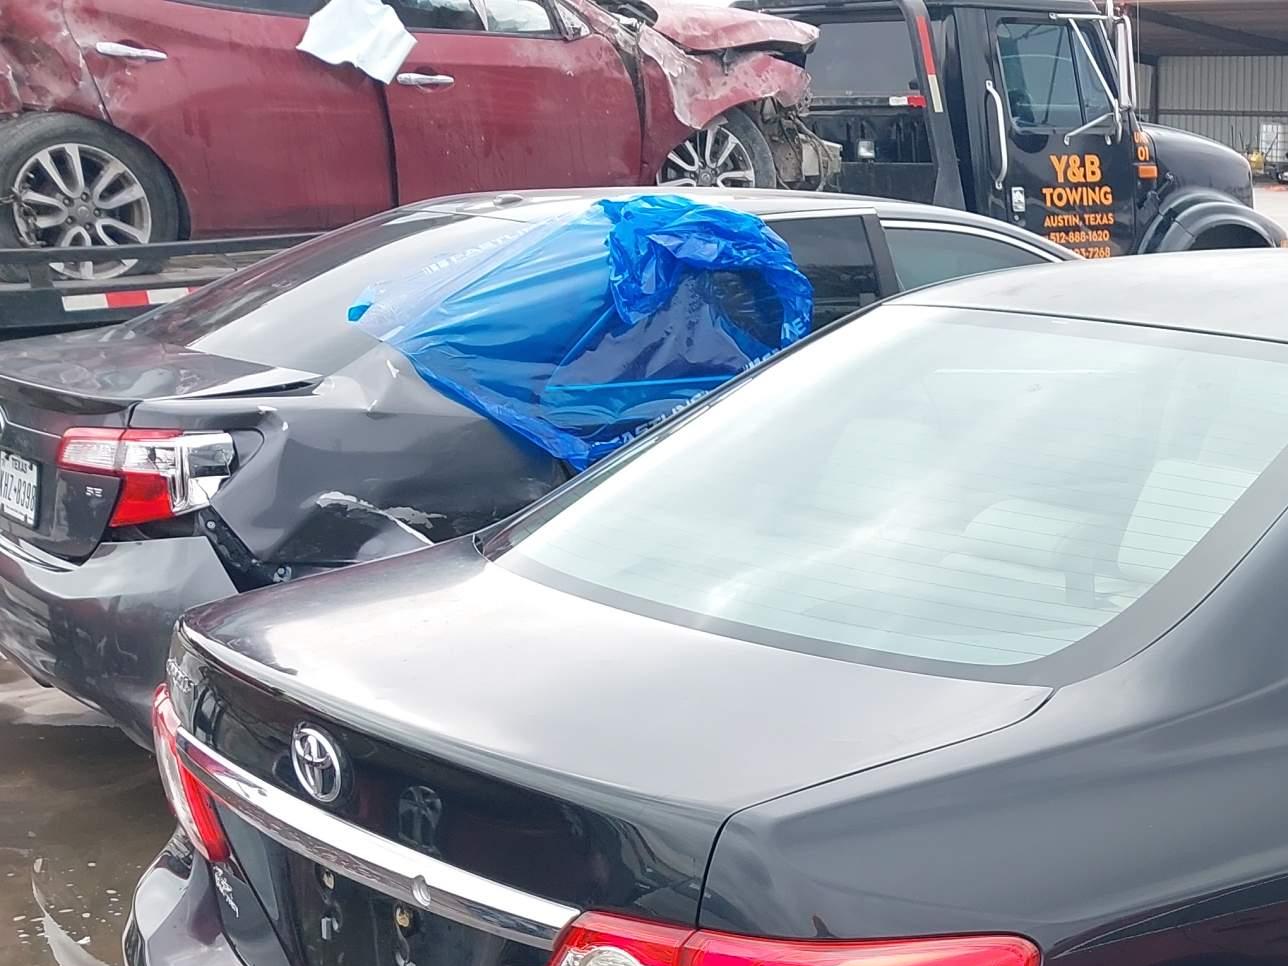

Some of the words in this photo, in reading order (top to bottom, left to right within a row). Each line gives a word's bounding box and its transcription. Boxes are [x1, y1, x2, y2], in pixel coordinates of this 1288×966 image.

[1049, 154, 1102, 183] Y&B
[1042, 186, 1113, 207] TOWING
[1044, 215, 1080, 227] AUSTIN,
[1084, 213, 1114, 225] TEXAS
[11, 457, 28, 474] TEXAS
[85, 486, 104, 497] SE
